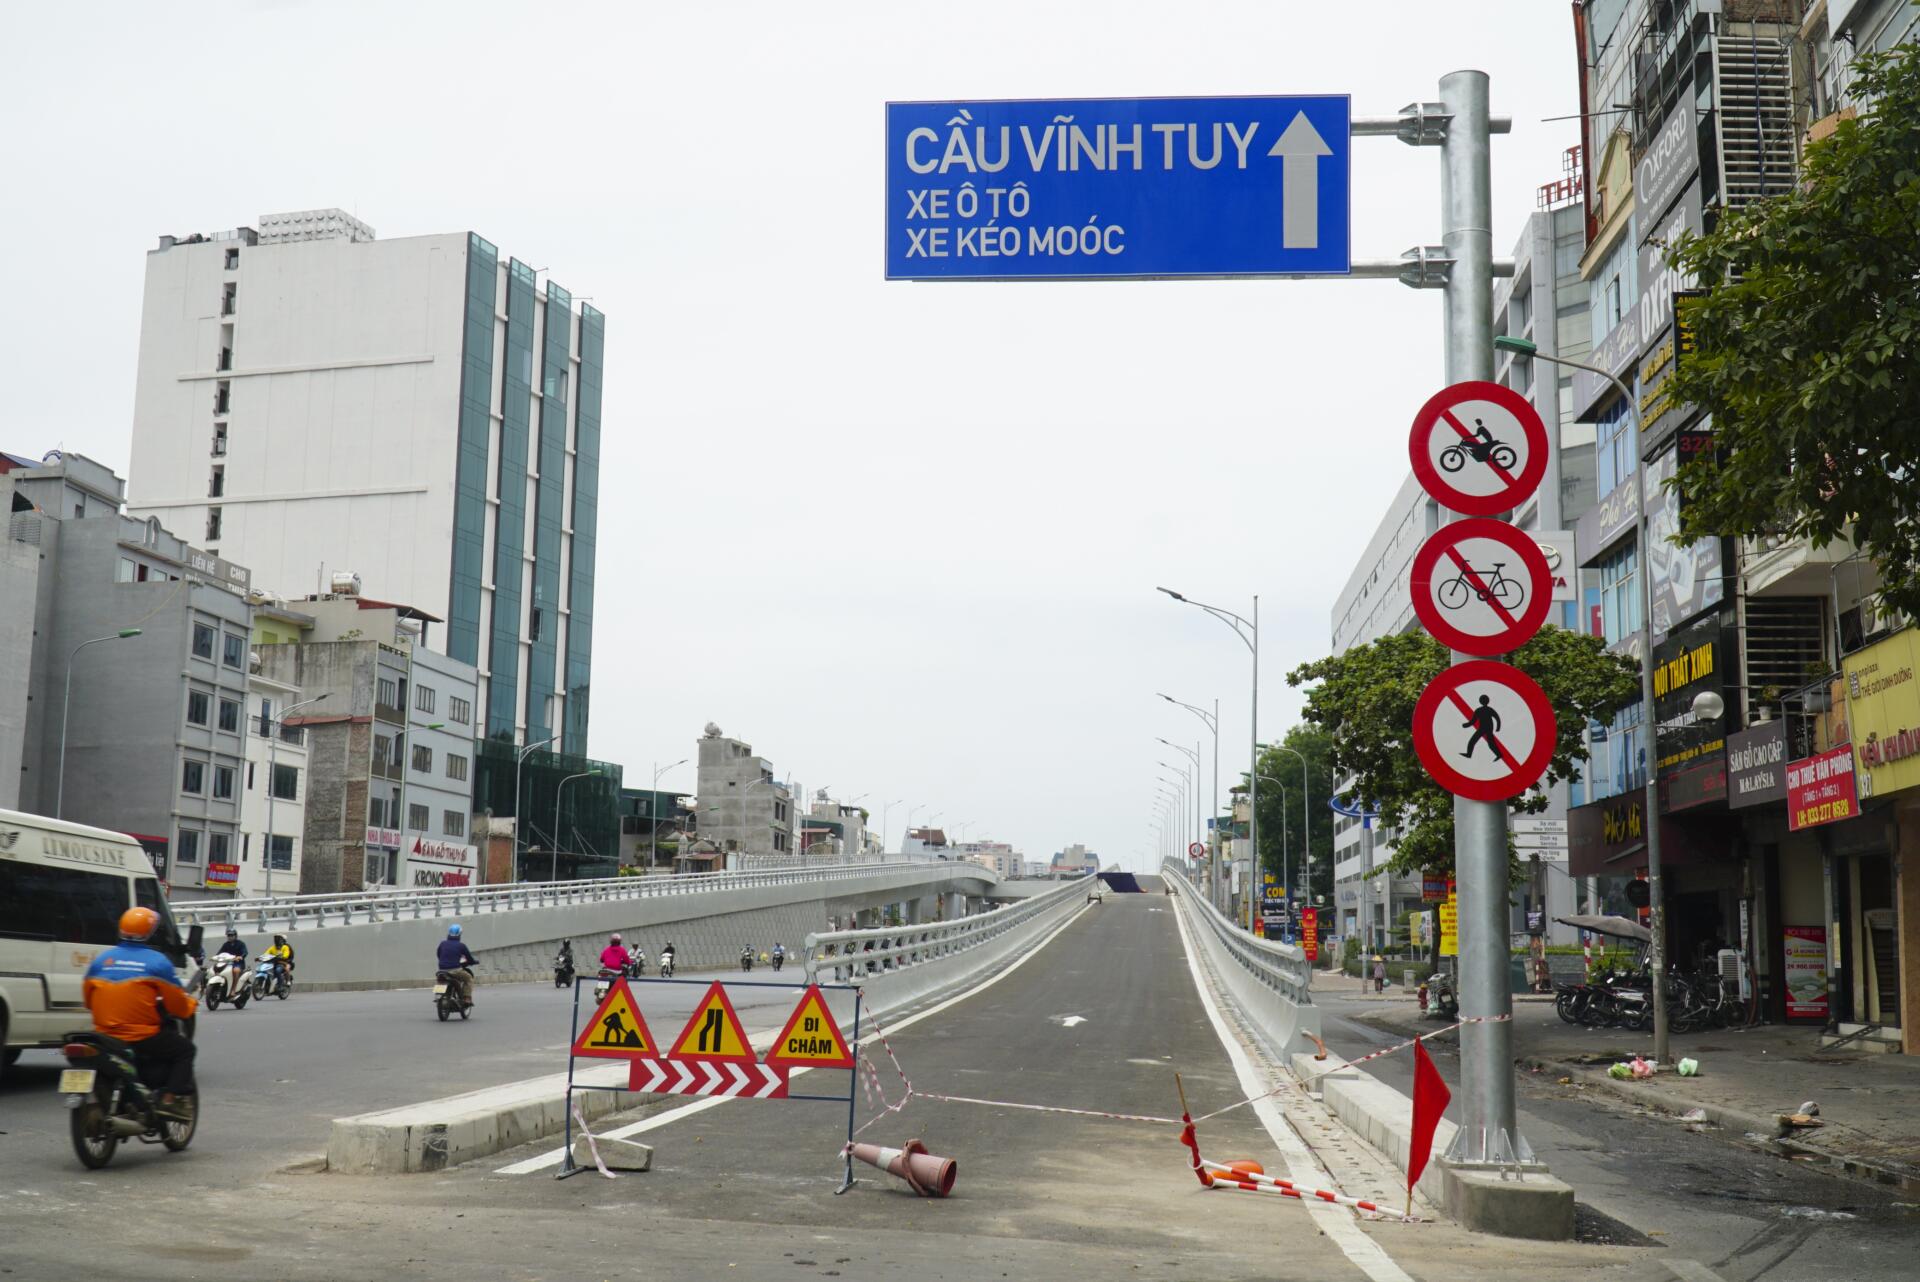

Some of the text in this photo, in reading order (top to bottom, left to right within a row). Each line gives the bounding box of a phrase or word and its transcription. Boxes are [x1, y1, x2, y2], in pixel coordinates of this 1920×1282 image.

[906, 109, 1260, 174] CẦU VĨNH TUY
[1640, 107, 1687, 204] OXFORD
[906, 181, 1030, 219] XE Ô TÔ
[905, 215, 1125, 258] XE KÉO MOÓC
[230, 566, 246, 582] CHO
[1654, 659, 1668, 702] NỘI
[1668, 646, 1689, 691] THẤT
[1690, 642, 1713, 681] XINH
[1731, 749, 1743, 773] SÀN
[1753, 745, 1767, 767] CAO
[1768, 736, 1782, 763] CẤP
[1788, 751, 1853, 790] CHO THUÊ VĂN PHÒNG
[1820, 803, 1831, 821] 277
[42, 837, 126, 866] LIMOUSINE
[804, 1017, 819, 1032] ĐI
[788, 1038, 832, 1057] CHẬM
